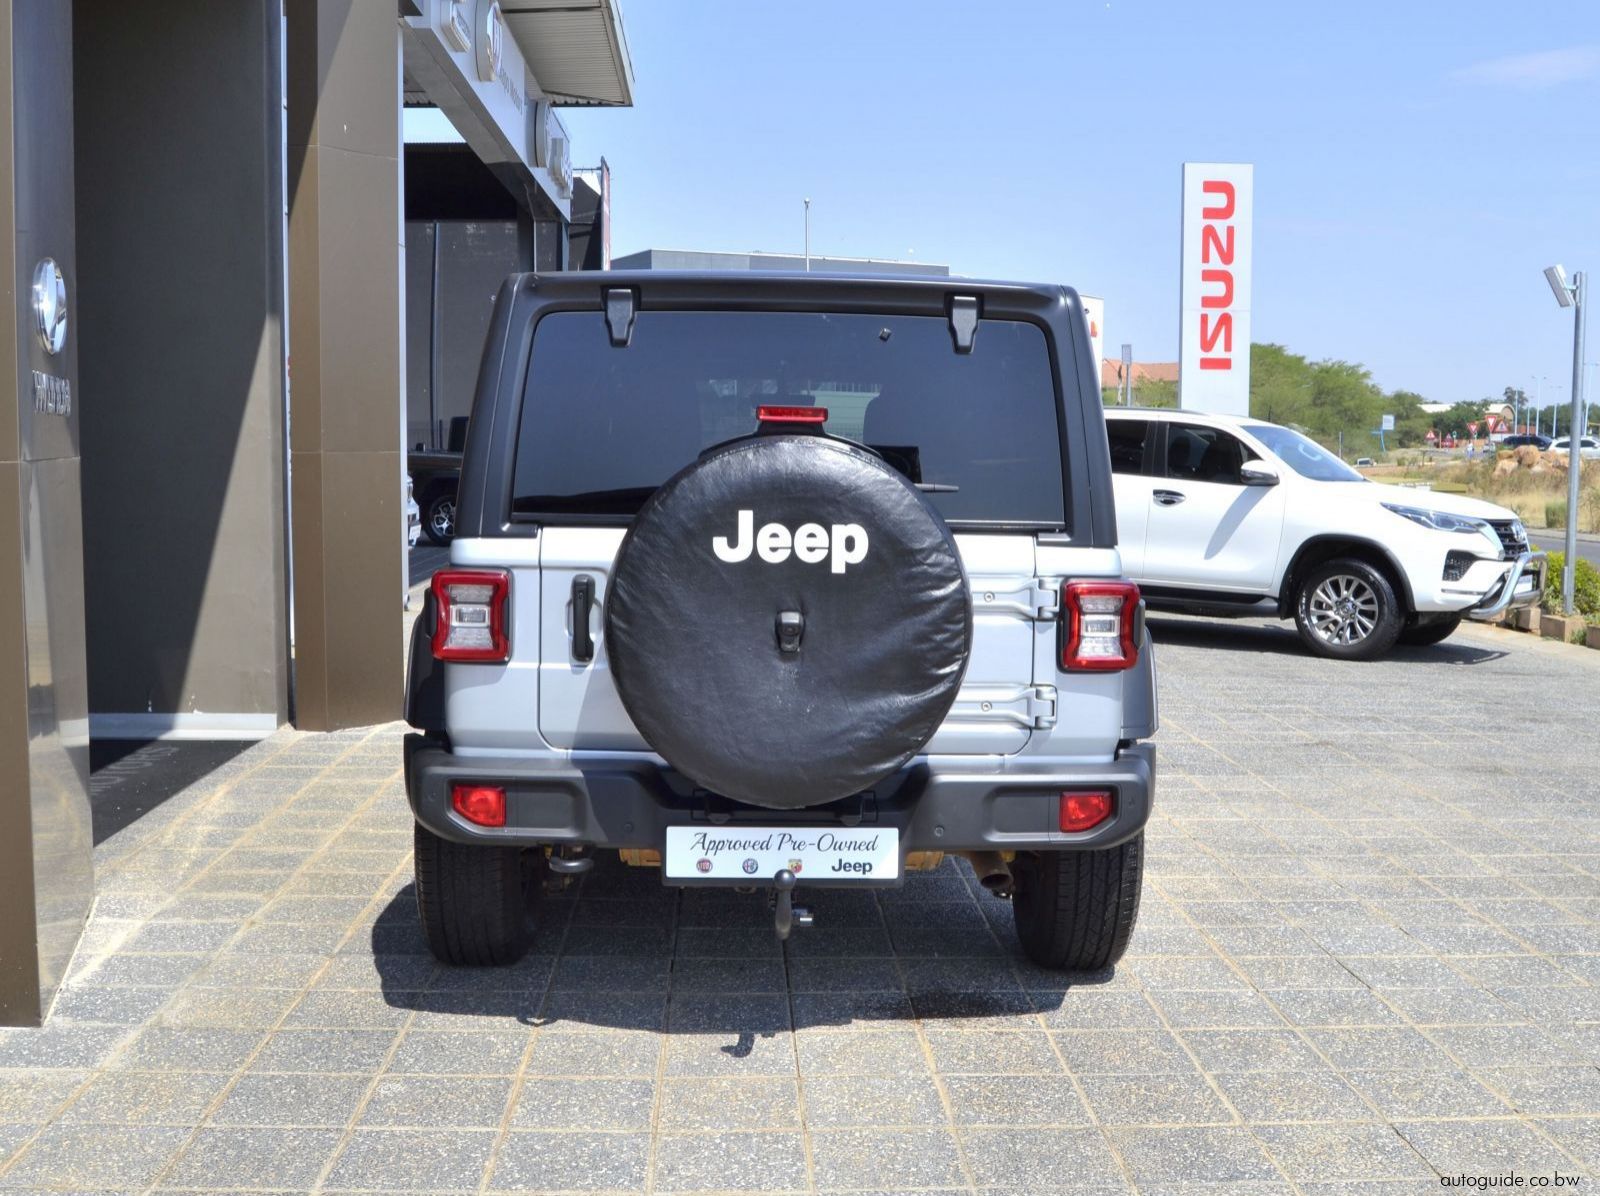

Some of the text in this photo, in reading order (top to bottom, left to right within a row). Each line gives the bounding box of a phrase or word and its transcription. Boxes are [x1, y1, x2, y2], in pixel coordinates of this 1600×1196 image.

[1200, 180, 1235, 370] ISUZU
[712, 509, 869, 574] Jeep
[690, 832, 879, 857] Approved Pre-Owned
[831, 858, 873, 875] Jeep
